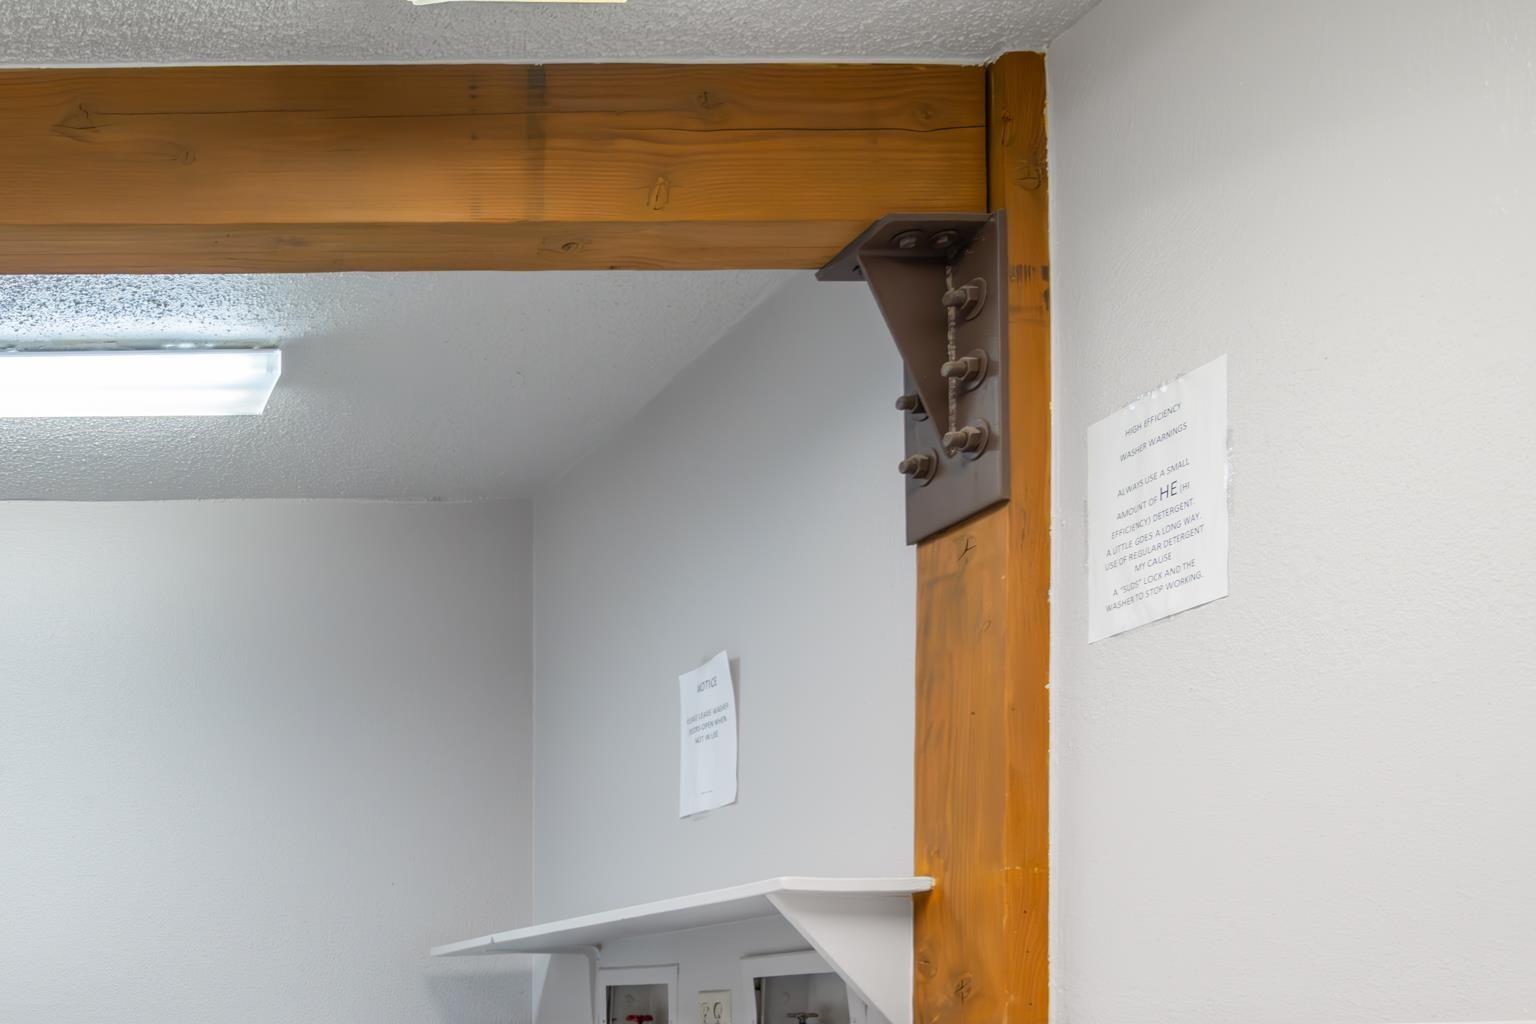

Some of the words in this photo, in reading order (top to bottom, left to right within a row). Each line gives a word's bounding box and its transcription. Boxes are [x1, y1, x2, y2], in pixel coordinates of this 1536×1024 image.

[1124, 422, 1142, 437] HIGH
[1144, 402, 1181, 428] EFFICIENCY
[1120, 442, 1147, 462] WASHER
[1148, 422, 1188, 448] WARNINGS
[1117, 478, 1144, 498] ALWAYS
[1144, 472, 1158, 484] USE
[1166, 457, 1190, 474] SMALL
[1116, 500, 1147, 520] AMOUNT
[1148, 496, 1158, 506] OF
[1159, 480, 1178, 500] HE
[1104, 560, 1118, 572] USE
[1118, 555, 1128, 566] OF
[1128, 542, 1162, 560] REGULAR
[1163, 524, 1204, 548] DETERGENT
[1112, 540, 1134, 556] LITTLE
[1134, 532, 1153, 546] GOES
[1162, 520, 1182, 536] LONG
[1134, 562, 1146, 573] MY
[1147, 552, 1172, 568] CAUSE
[1144, 572, 1164, 585] LOCK
[1164, 564, 1182, 578] AND
[1182, 558, 1196, 571] THE
[1106, 596, 1135, 612] WASHER
[1135, 592, 1144, 601] TO
[1145, 584, 1164, 598] STOP
[696, 676, 718, 693] NOTICE
